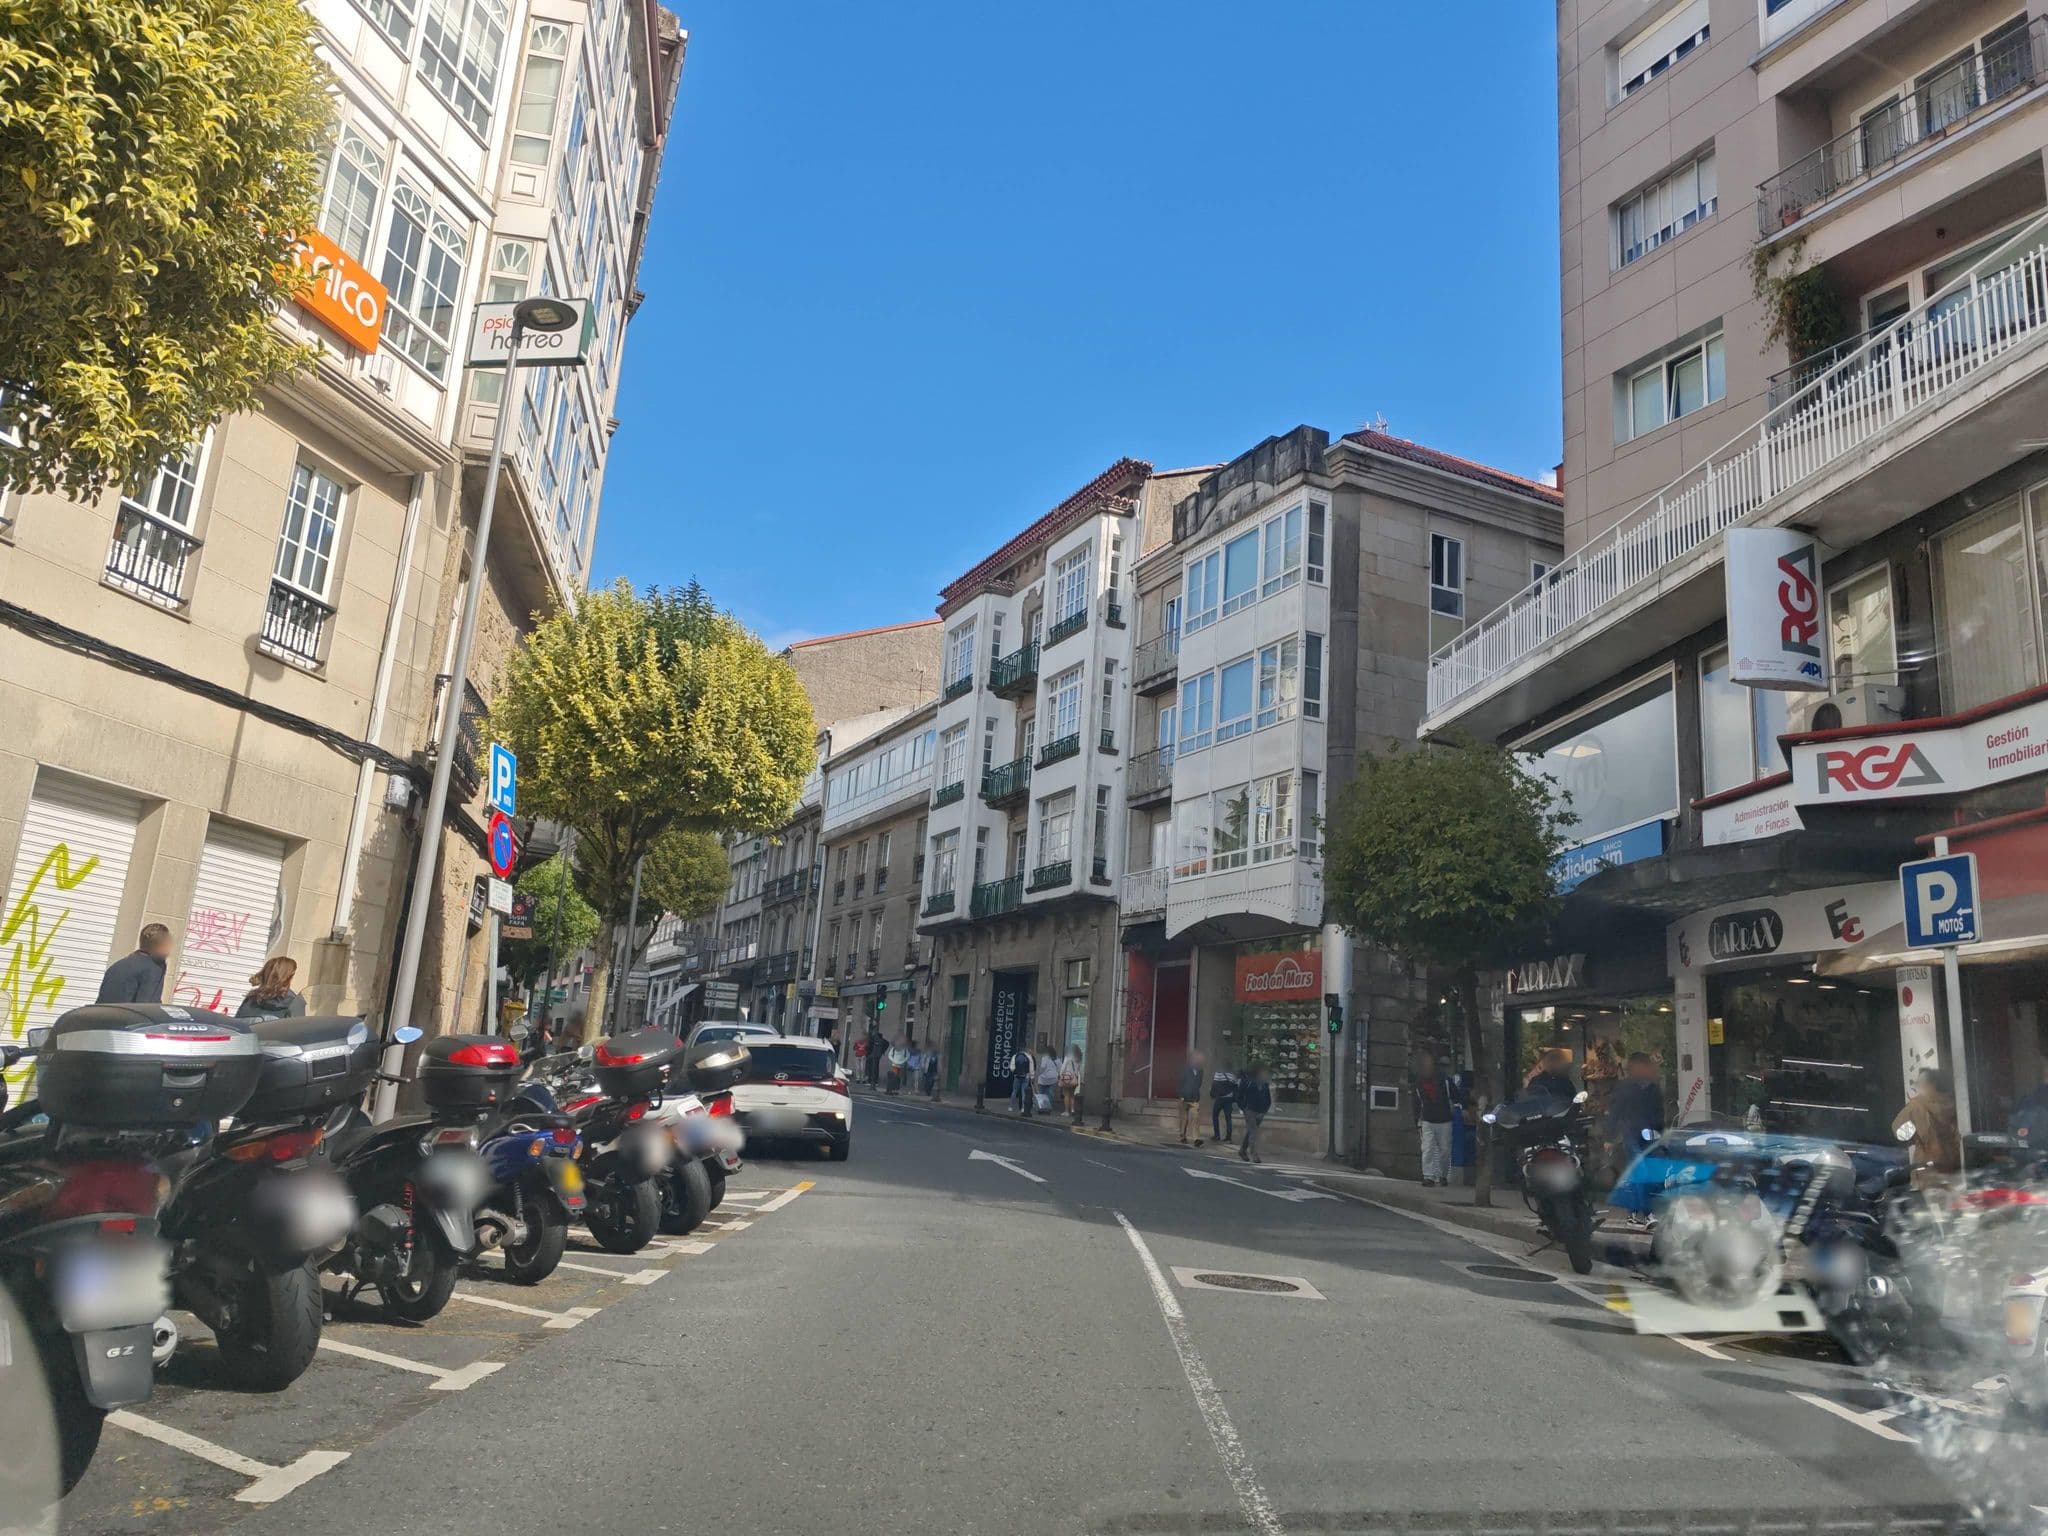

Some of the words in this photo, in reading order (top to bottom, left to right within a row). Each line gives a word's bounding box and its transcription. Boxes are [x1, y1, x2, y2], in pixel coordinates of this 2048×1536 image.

[1777, 543, 1821, 658] RGA
[1986, 725, 2029, 749] Gestión
[1816, 742, 1945, 795] RGA
[1734, 798, 1789, 825] Administración
[1754, 822, 1764, 835] de
[1602, 839, 1623, 853] BANCO
[1916, 869, 1958, 937] P
[1938, 916, 1965, 935] MOTOS
[1244, 973, 1268, 992] Foot
[1268, 973, 1284, 990] on
[1284, 969, 1314, 989] Mars
[996, 990, 1006, 1032] MÉDICO
[168, 1024, 208, 1032] SHAD
[1001, 991, 1016, 1078] COMPOSTELA
[992, 1034, 1004, 1078] CENTRO
[106, 1345, 135, 1358] GZ
